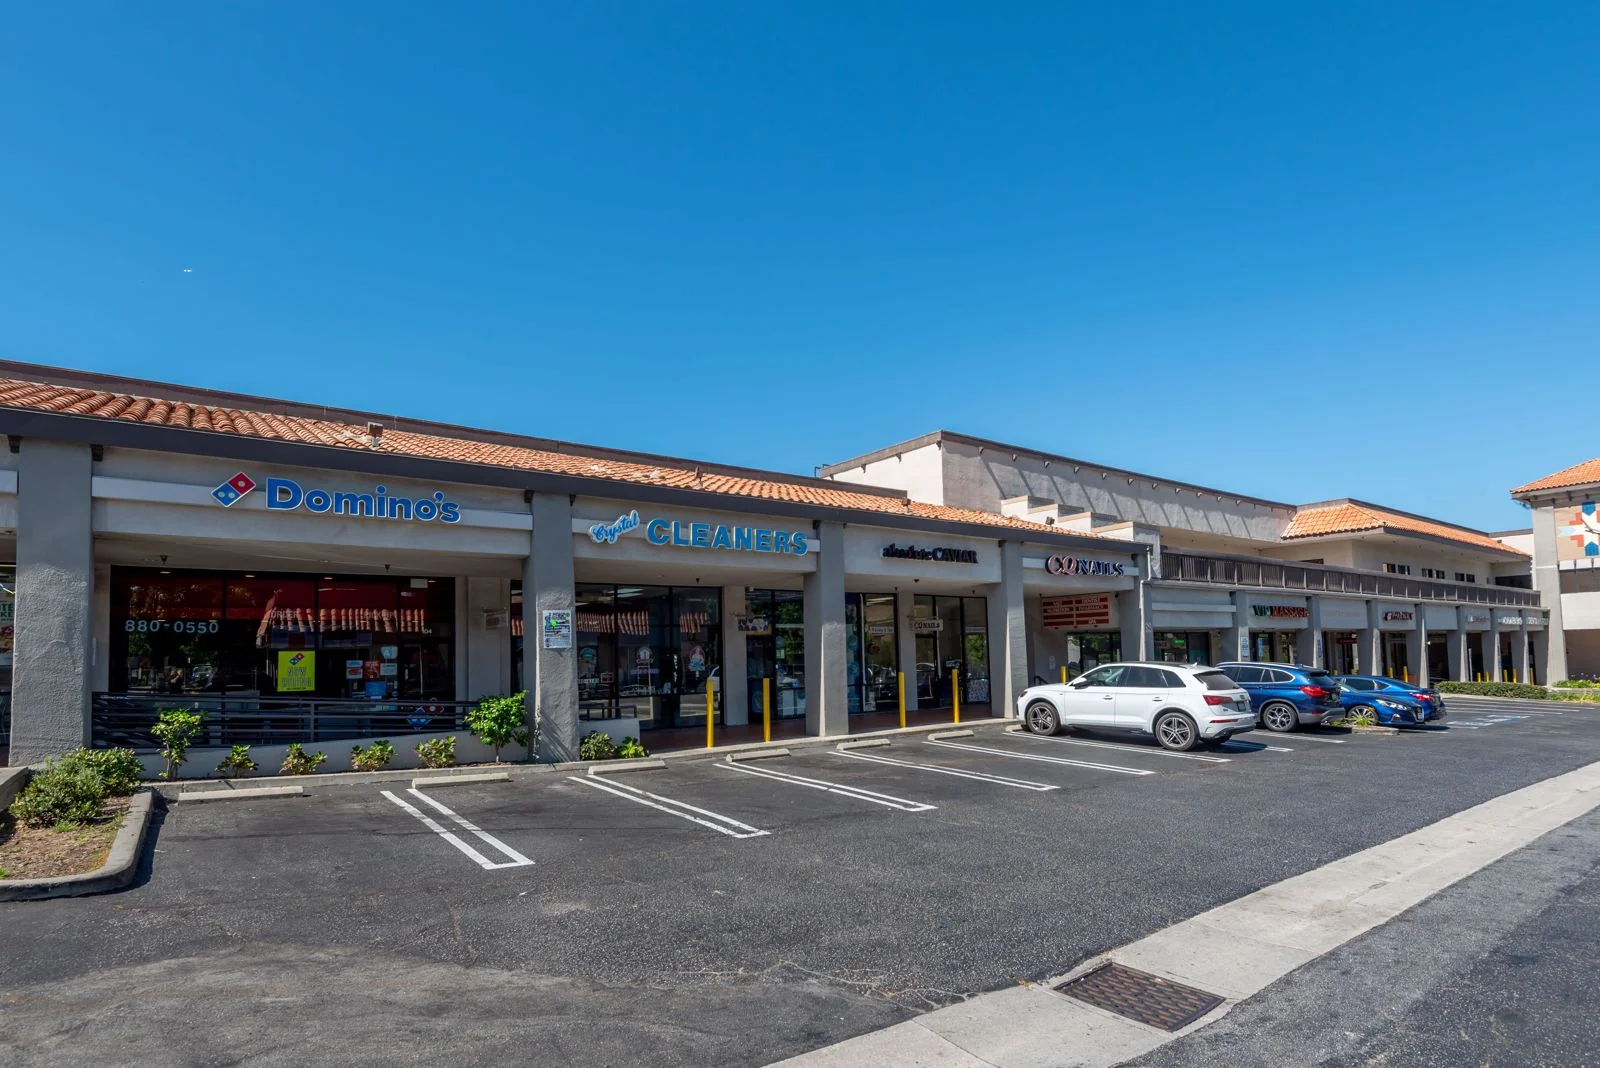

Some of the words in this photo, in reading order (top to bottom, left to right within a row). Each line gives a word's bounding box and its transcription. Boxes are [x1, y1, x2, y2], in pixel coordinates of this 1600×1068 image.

[266, 476, 461, 524] Domino's
[590, 510, 640, 544] Crystal
[647, 517, 808, 556] CLEANERS
[933, 547, 978, 563] CAVIAR
[1077, 558, 1124, 577] NAILS
[1271, 606, 1309, 618] MASSAGE
